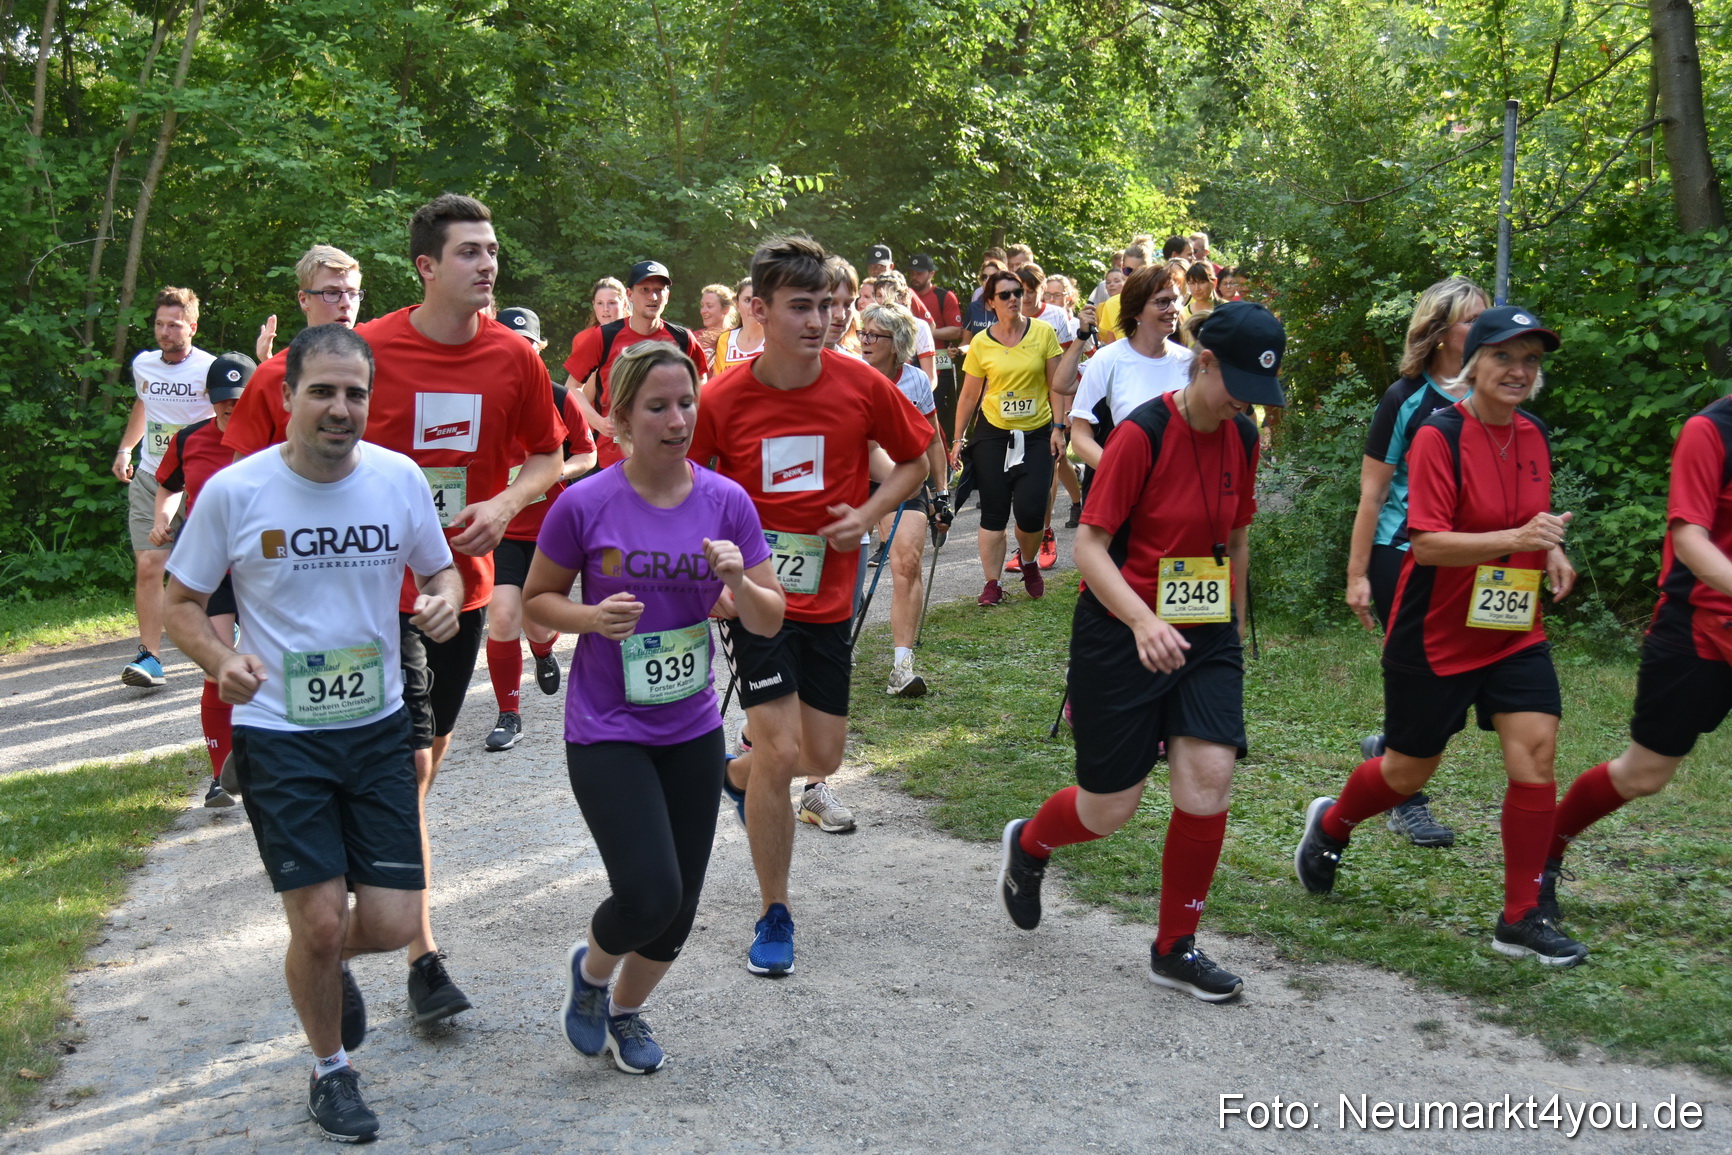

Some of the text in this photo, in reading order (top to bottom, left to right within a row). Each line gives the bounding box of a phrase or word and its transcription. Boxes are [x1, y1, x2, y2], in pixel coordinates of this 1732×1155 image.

[149, 382, 197, 396] GRADL
[1003, 399, 1033, 412] 2197
[155, 434, 170, 447] 94
[436, 426, 458, 436] DEHN
[433, 489, 446, 511] 4
[290, 524, 399, 557] GRADL
[769, 553, 805, 577] 72
[1165, 581, 1219, 605] 2348
[1478, 588, 1529, 614] 2364
[645, 652, 695, 685] 939
[308, 672, 365, 704] 942
[749, 671, 783, 691] hummel
